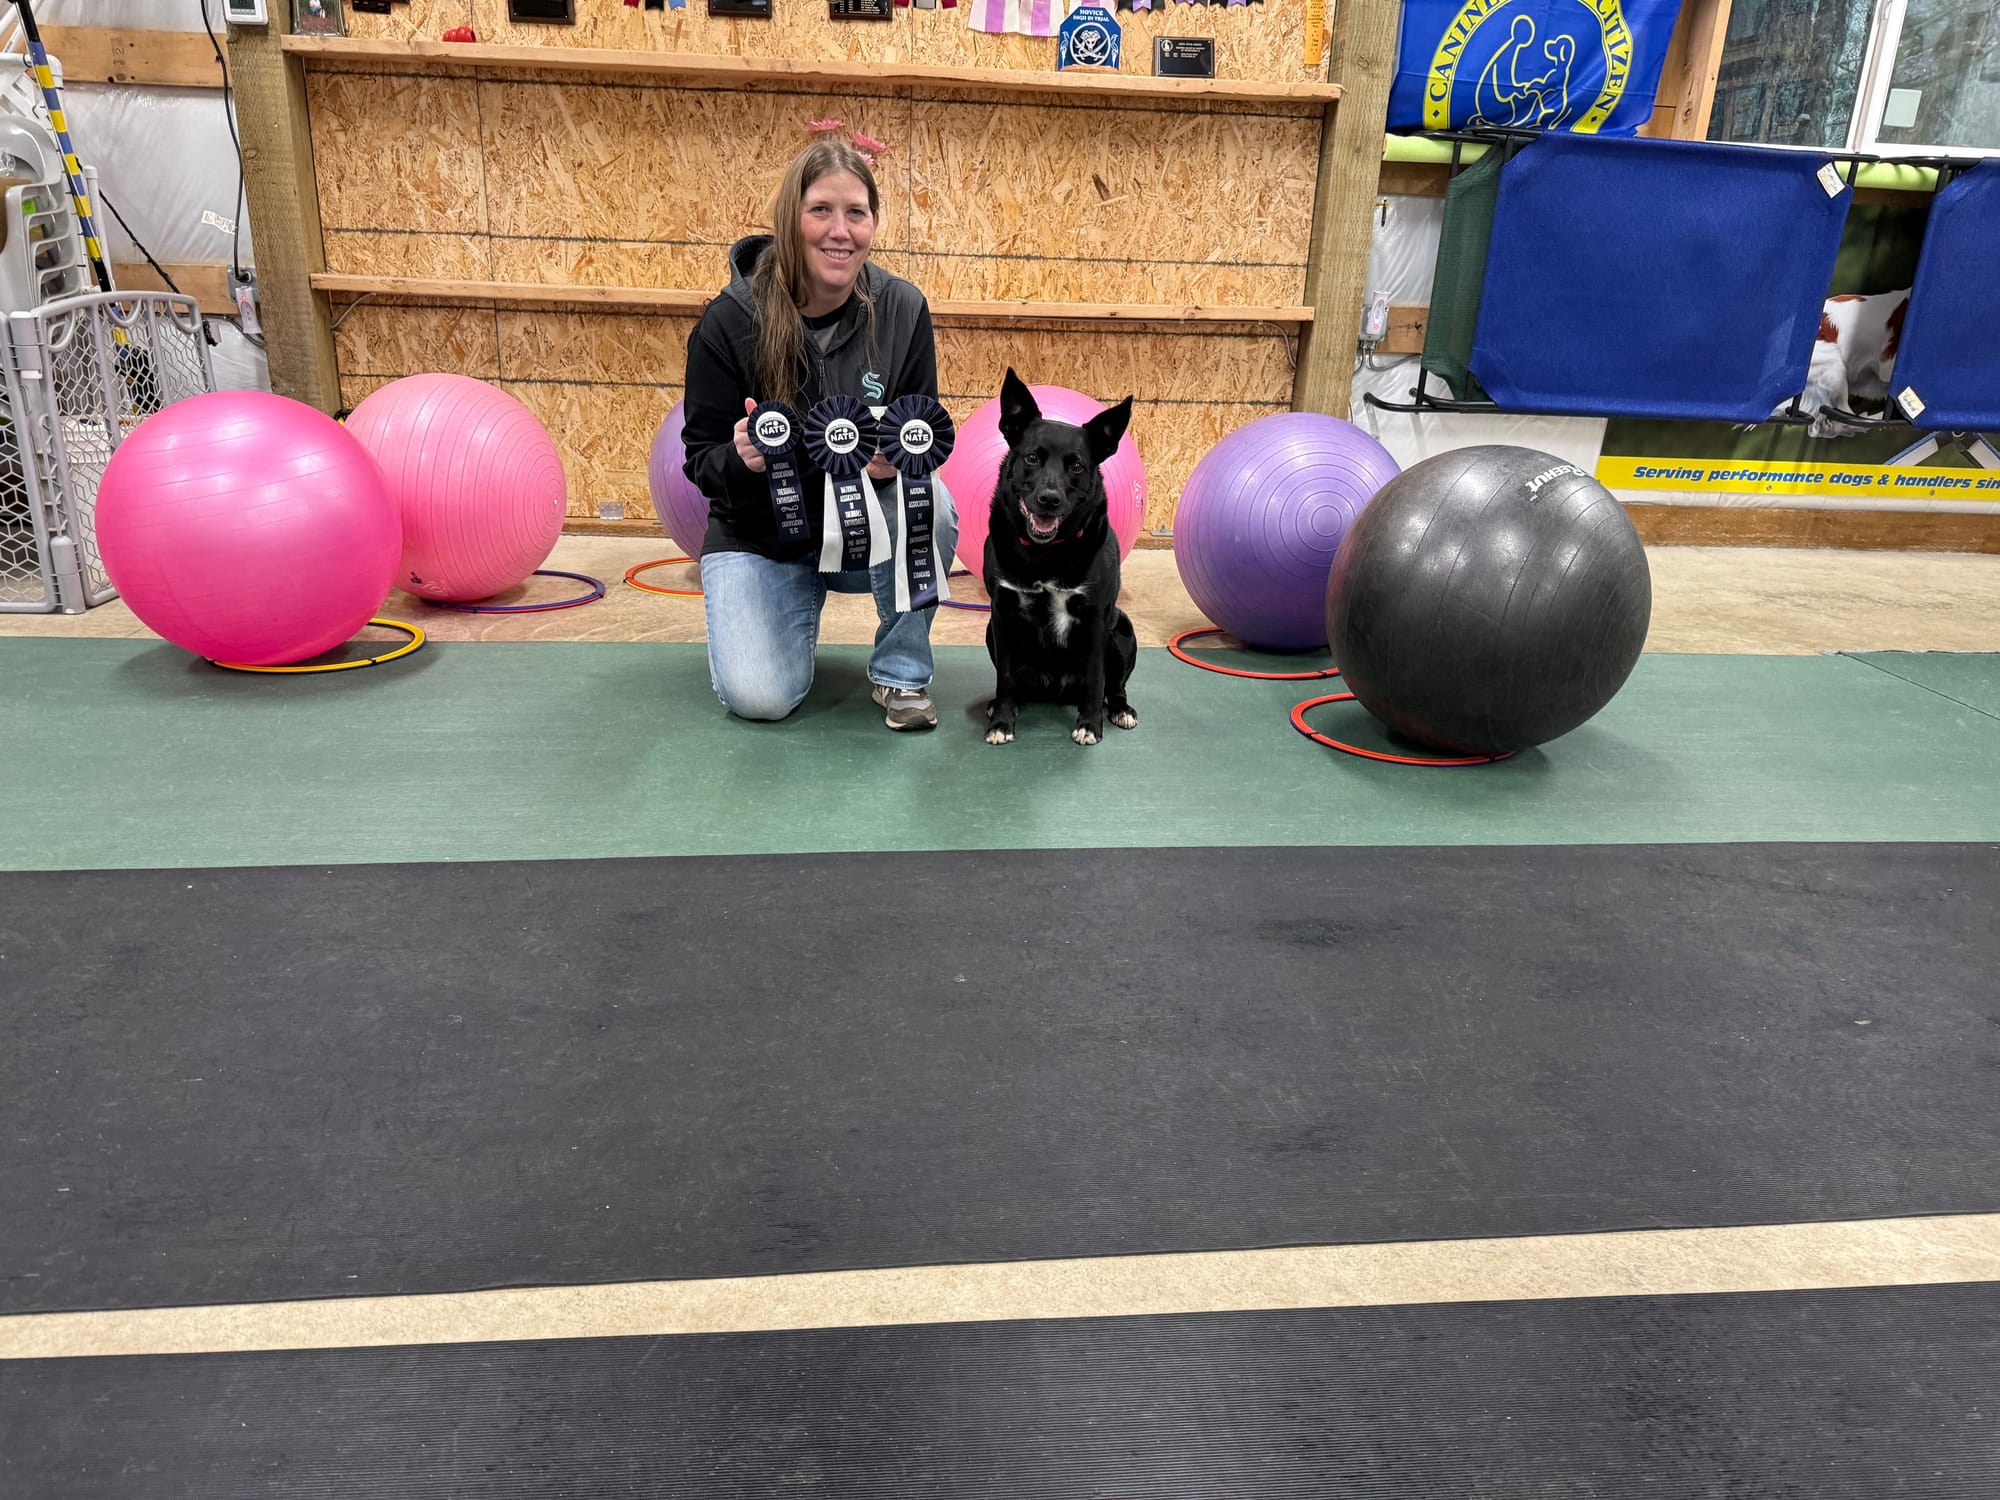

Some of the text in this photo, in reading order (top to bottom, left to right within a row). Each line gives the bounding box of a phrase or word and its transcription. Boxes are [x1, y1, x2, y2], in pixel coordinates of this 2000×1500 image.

[1594, 0, 1630, 113] CITIZEN
[761, 424, 786, 435] NATE
[830, 432, 855, 442] NATE
[905, 434, 929, 442] NATE
[1633, 466, 1705, 482] Serving
[1707, 468, 1824, 484] performance
[1829, 472, 1873, 486] dogs
[1877, 474, 1890, 486] &
[1894, 474, 1973, 489] handlers
